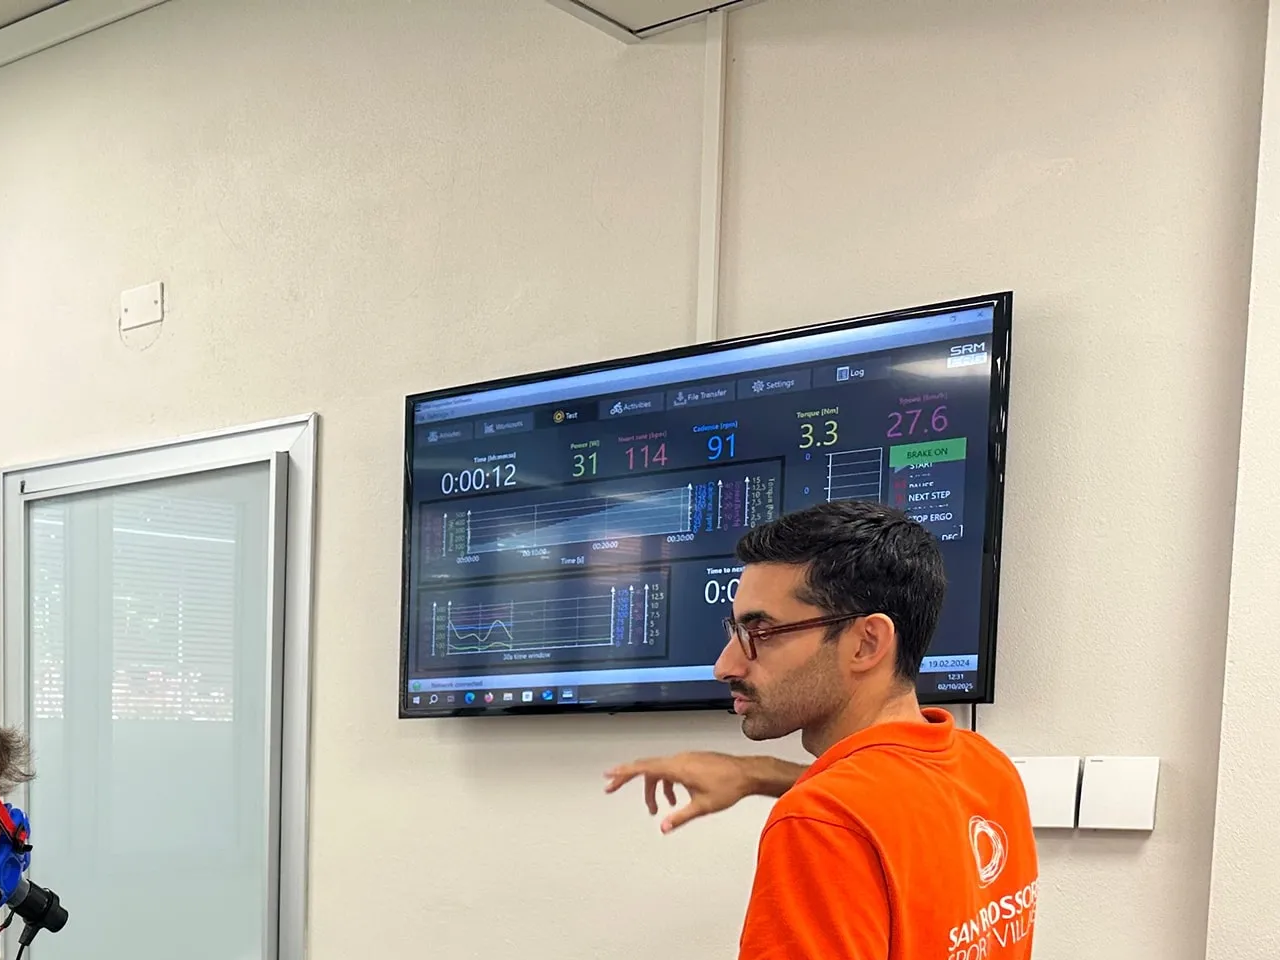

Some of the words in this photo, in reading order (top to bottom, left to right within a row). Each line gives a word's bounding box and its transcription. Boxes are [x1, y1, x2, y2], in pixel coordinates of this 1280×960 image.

[950, 342, 985, 356] SRM
[850, 368, 864, 378] Log
[766, 378, 795, 390] Settings
[687, 393, 699, 401] File
[701, 389, 727, 400] Transfer
[623, 400, 651, 411] Activities
[566, 411, 578, 420] Test
[796, 409, 819, 420] Torque
[821, 406, 839, 417] [Nm]
[693, 423, 718, 433] Cadence
[886, 405, 948, 439] 27.6
[799, 420, 839, 449] 3.3
[707, 433, 736, 460] 91
[625, 443, 668, 470] 114
[907, 449, 934, 459] BRAKE
[934, 447, 948, 456] ON
[572, 452, 597, 477] 31
[441, 463, 517, 495] 0:00:12
[908, 492, 930, 503] NEXT
[931, 490, 951, 501] STEP
[930, 512, 953, 523] ERGO
[666, 533, 694, 543] 00:30:00
[528, 652, 551, 660] window
[929, 659, 970, 668] 19.02.2024
[937, 682, 974, 691] 02/10/2025
